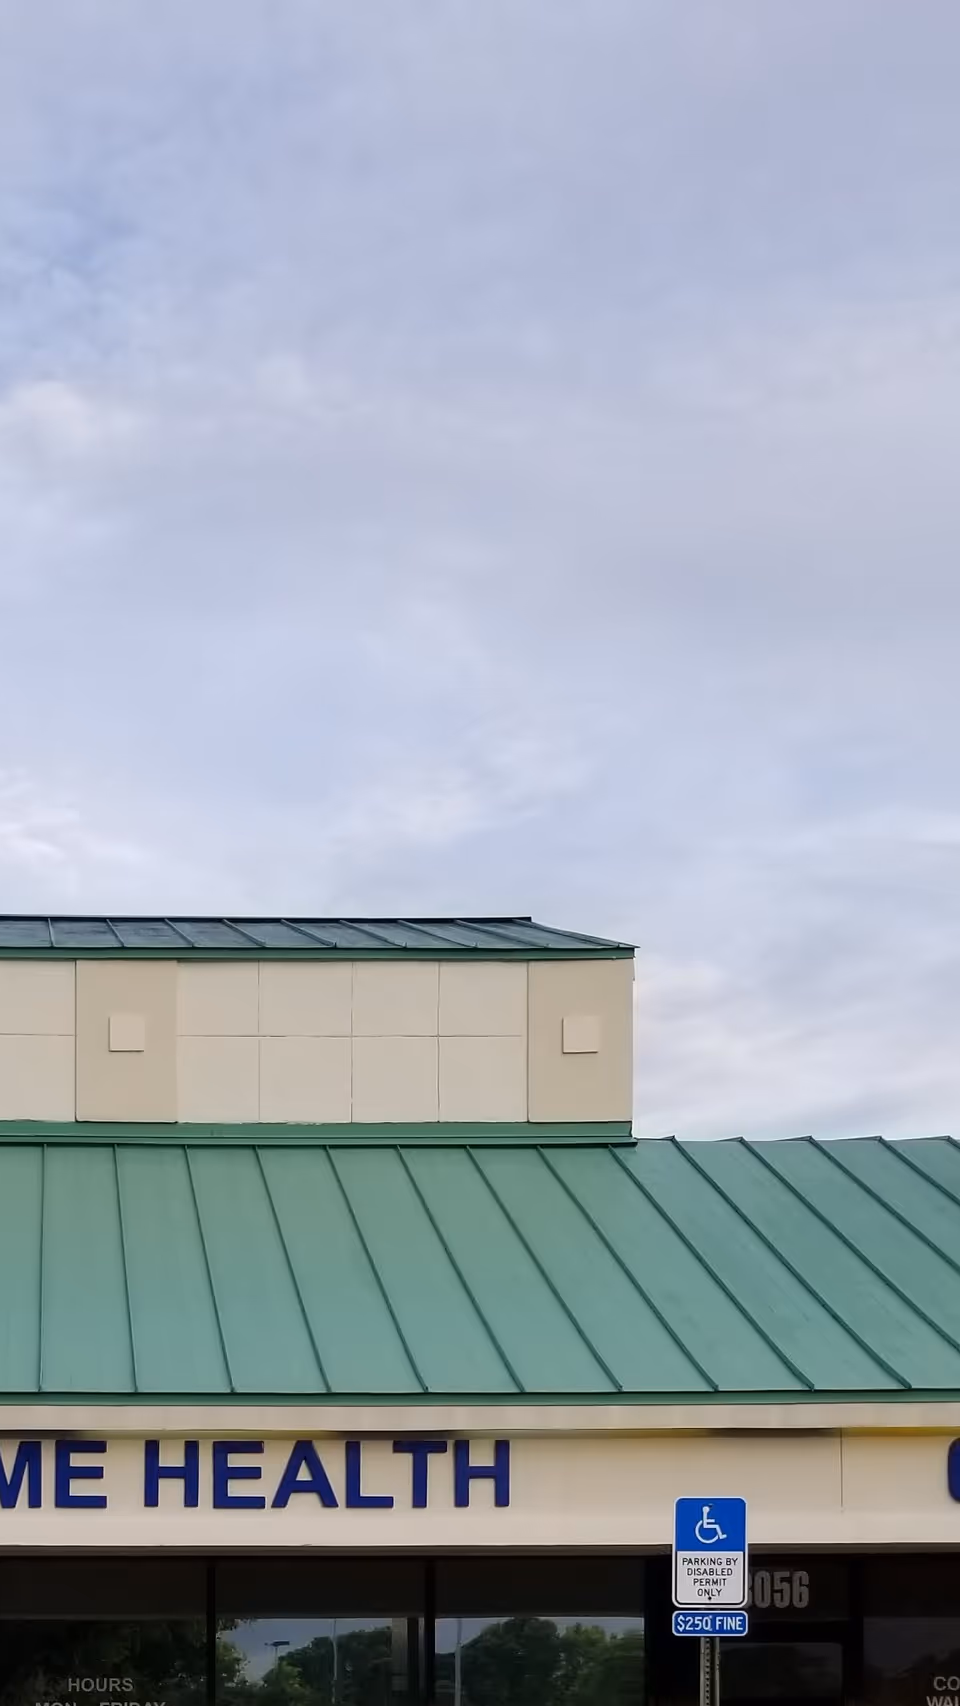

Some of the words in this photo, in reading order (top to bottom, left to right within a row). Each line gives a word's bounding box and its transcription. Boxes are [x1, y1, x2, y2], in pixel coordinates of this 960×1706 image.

[144, 1440, 510, 1509] HEALTH
[682, 1557, 722, 1566] PARKING
[725, 1557, 738, 1566] BY
[686, 1568, 733, 1576] DISABLED
[693, 1578, 727, 1587] PERMIT
[697, 1588, 722, 1597] ONLY
[677, 1615, 712, 1632] $250
[715, 1616, 744, 1631] FINE
[68, 1677, 134, 1692] HOURS
